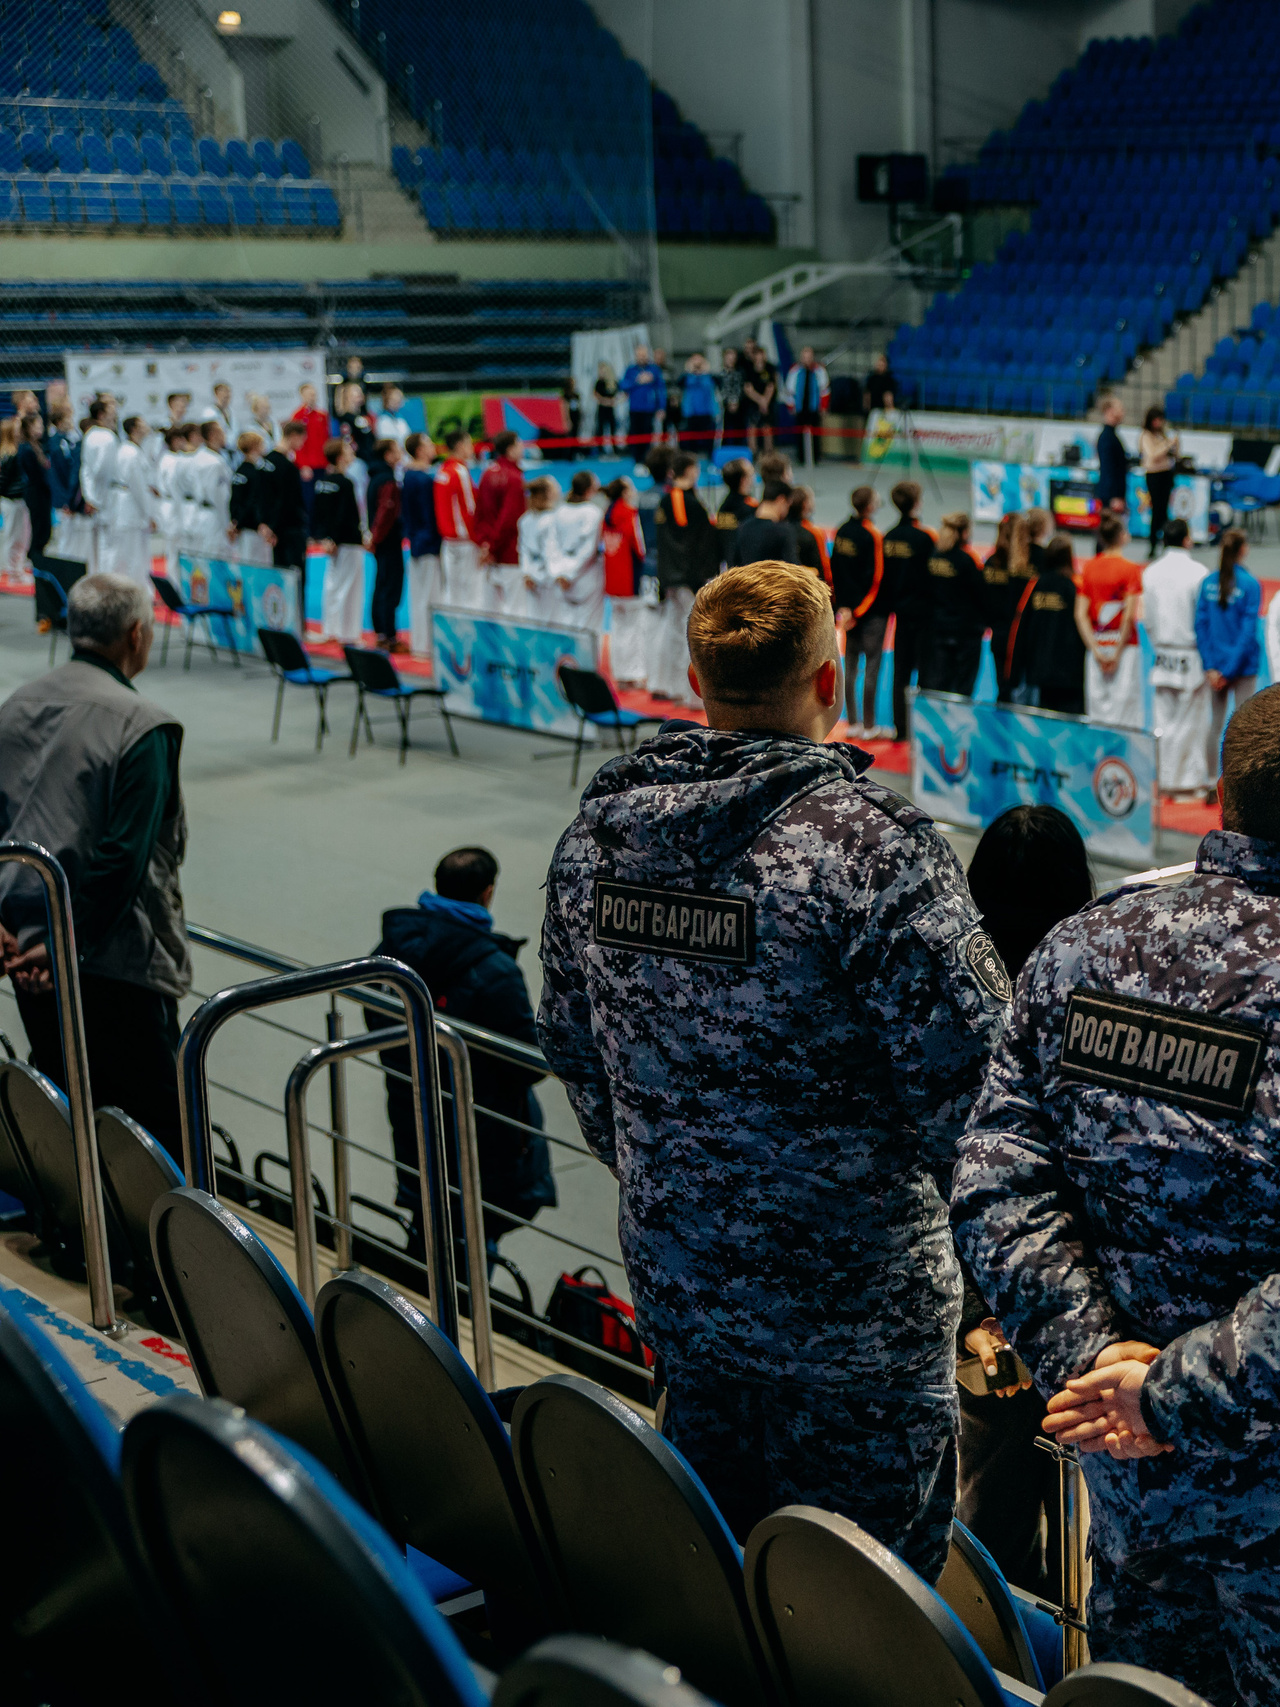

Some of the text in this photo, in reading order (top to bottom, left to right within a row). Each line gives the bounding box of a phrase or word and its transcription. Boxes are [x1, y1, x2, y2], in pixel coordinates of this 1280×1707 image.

[1155, 652, 1190, 675] RUS
[601, 894, 737, 949] РОСГВАРДИЯ
[1068, 1011, 1240, 1091] РОСГВАРДИЯ
